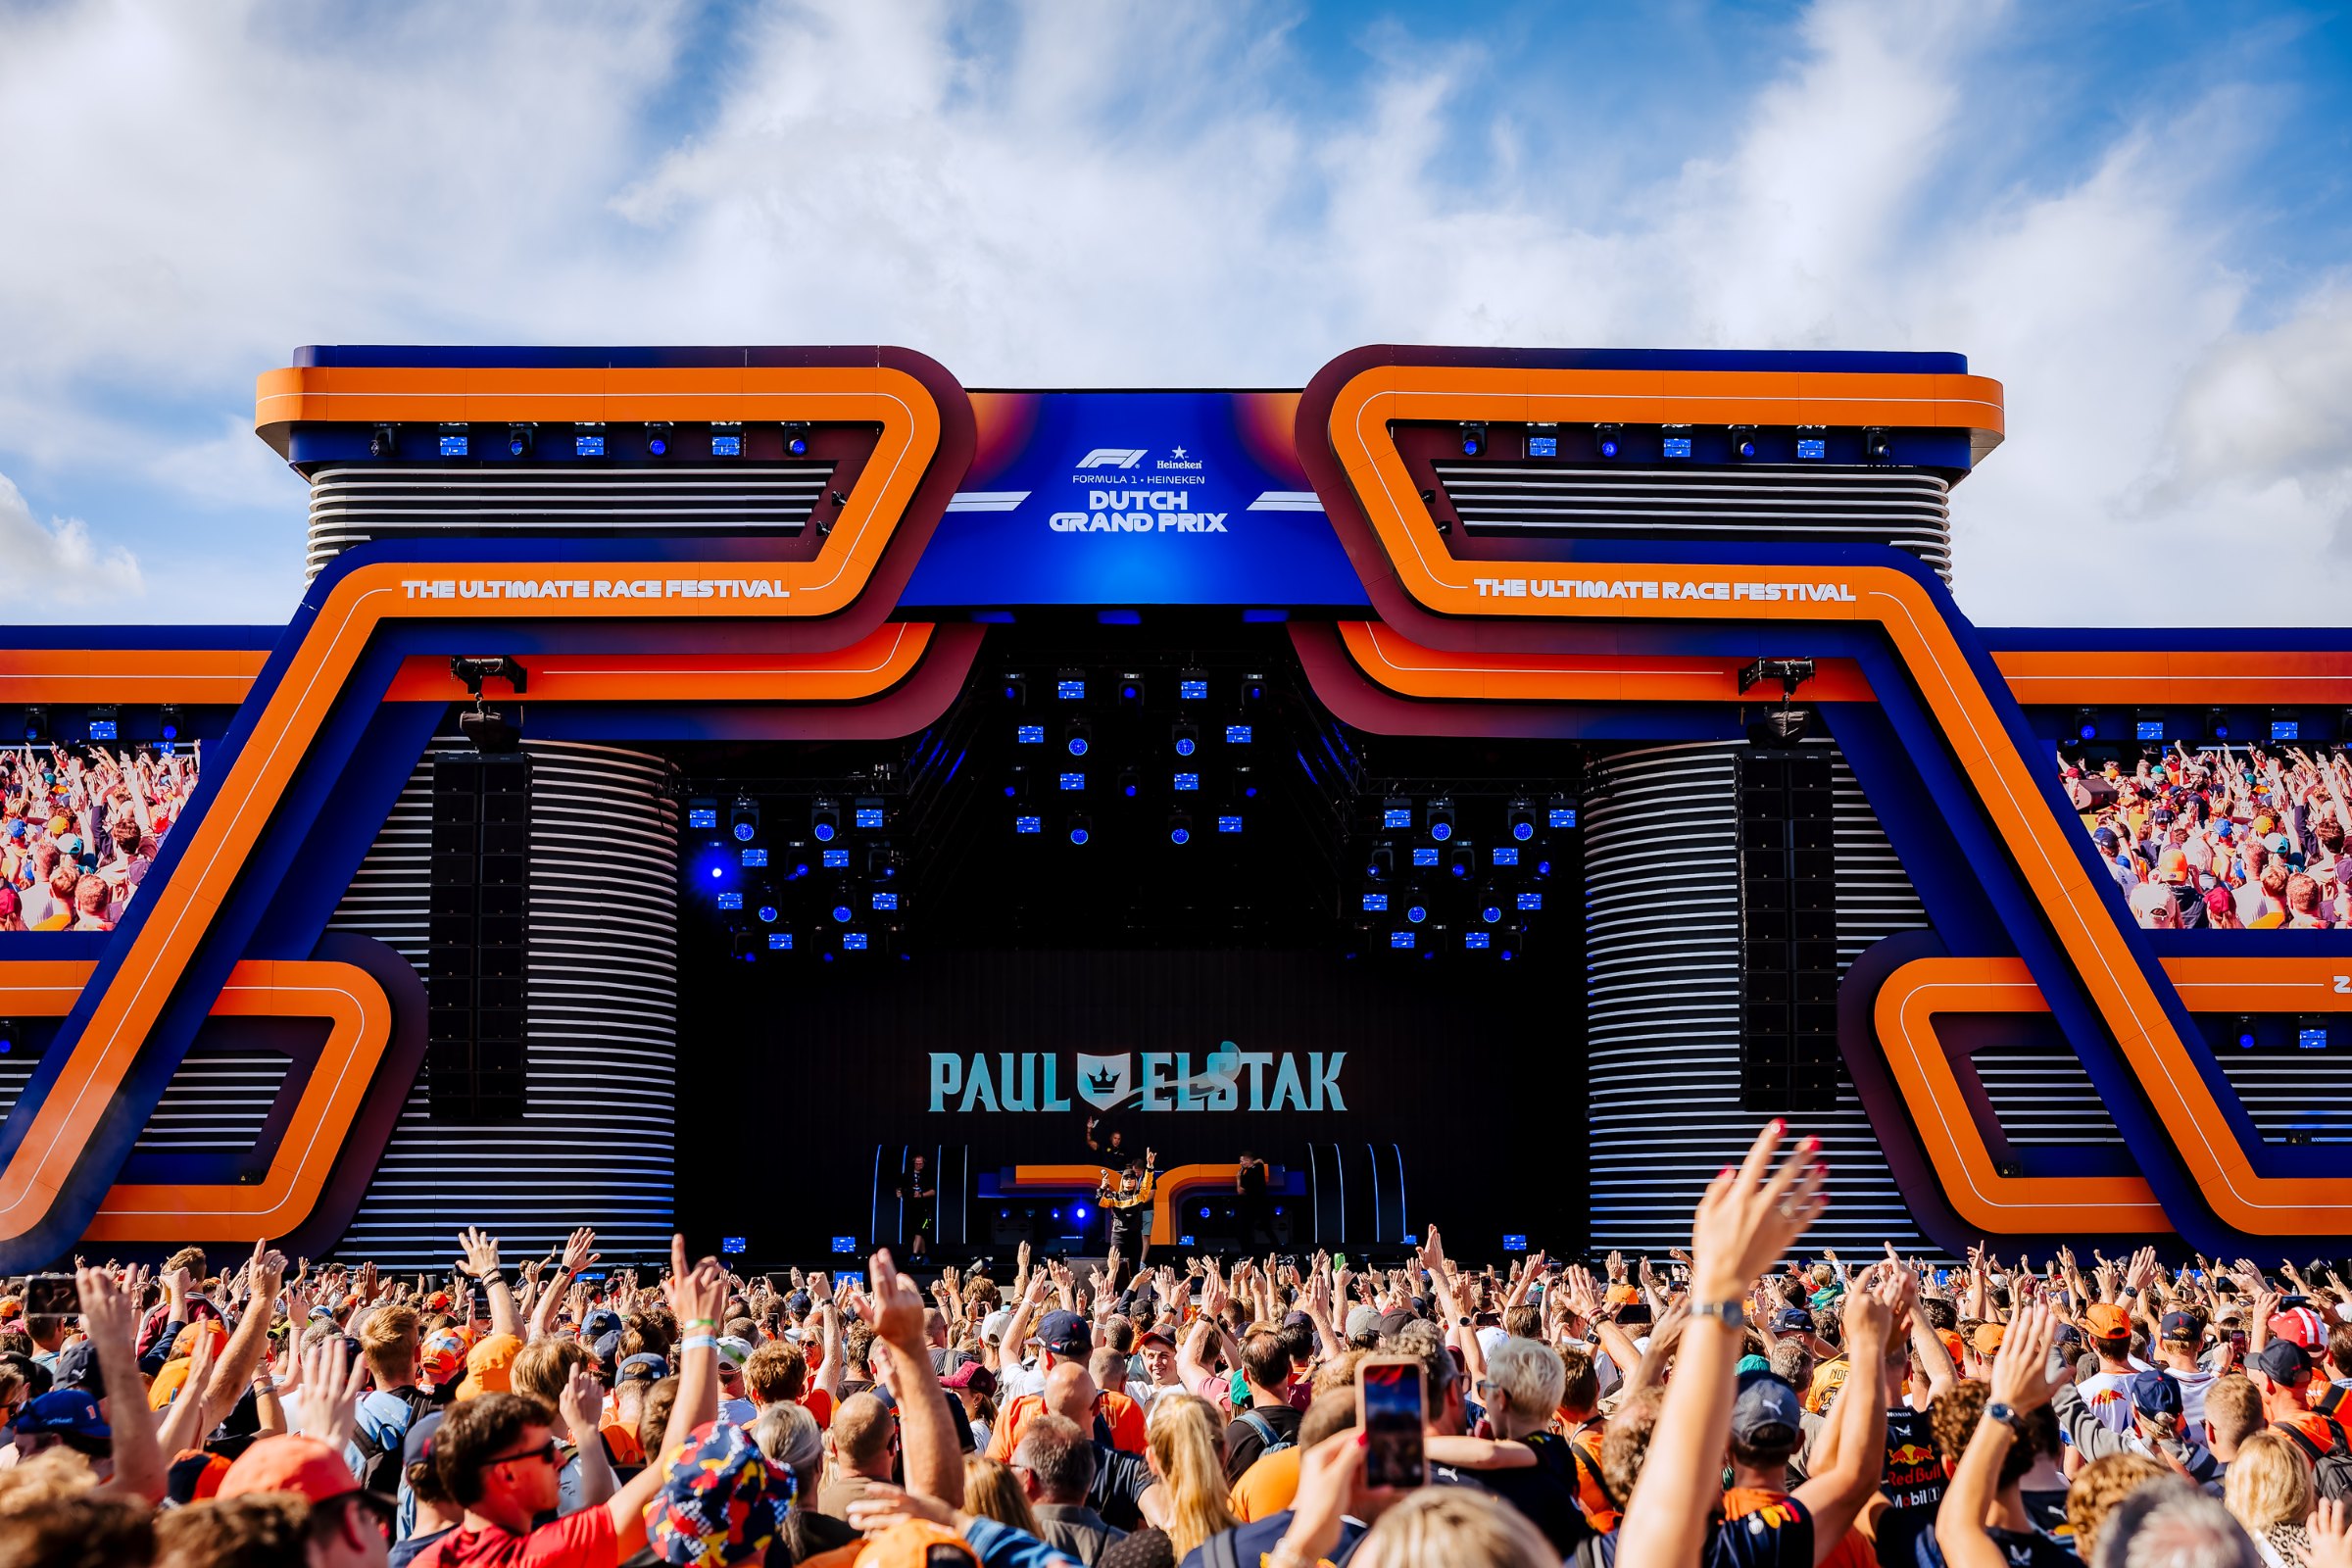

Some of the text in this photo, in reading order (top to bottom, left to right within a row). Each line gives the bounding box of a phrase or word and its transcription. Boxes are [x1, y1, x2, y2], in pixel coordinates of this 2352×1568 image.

[1075, 448, 1149, 468] F1
[1156, 460, 1202, 469] Heineken
[1072, 474, 1127, 484] FORMULA
[1147, 475, 1205, 484] HEINEKEN
[1089, 490, 1188, 511] DUTCH
[1049, 512, 1228, 532] GRAND PRIX
[402, 580, 790, 599] THE ULTIMATE RACE FESTIVAL
[1473, 578, 1856, 602] THE ULTIMATE RACE FESTIVAL
[2333, 975, 2352, 994] Z
[928, 1052, 1348, 1112] PAUL ELSTAK
[1887, 1463, 1940, 1486] Red Bull
[1892, 1490, 1928, 1508] Mobil
